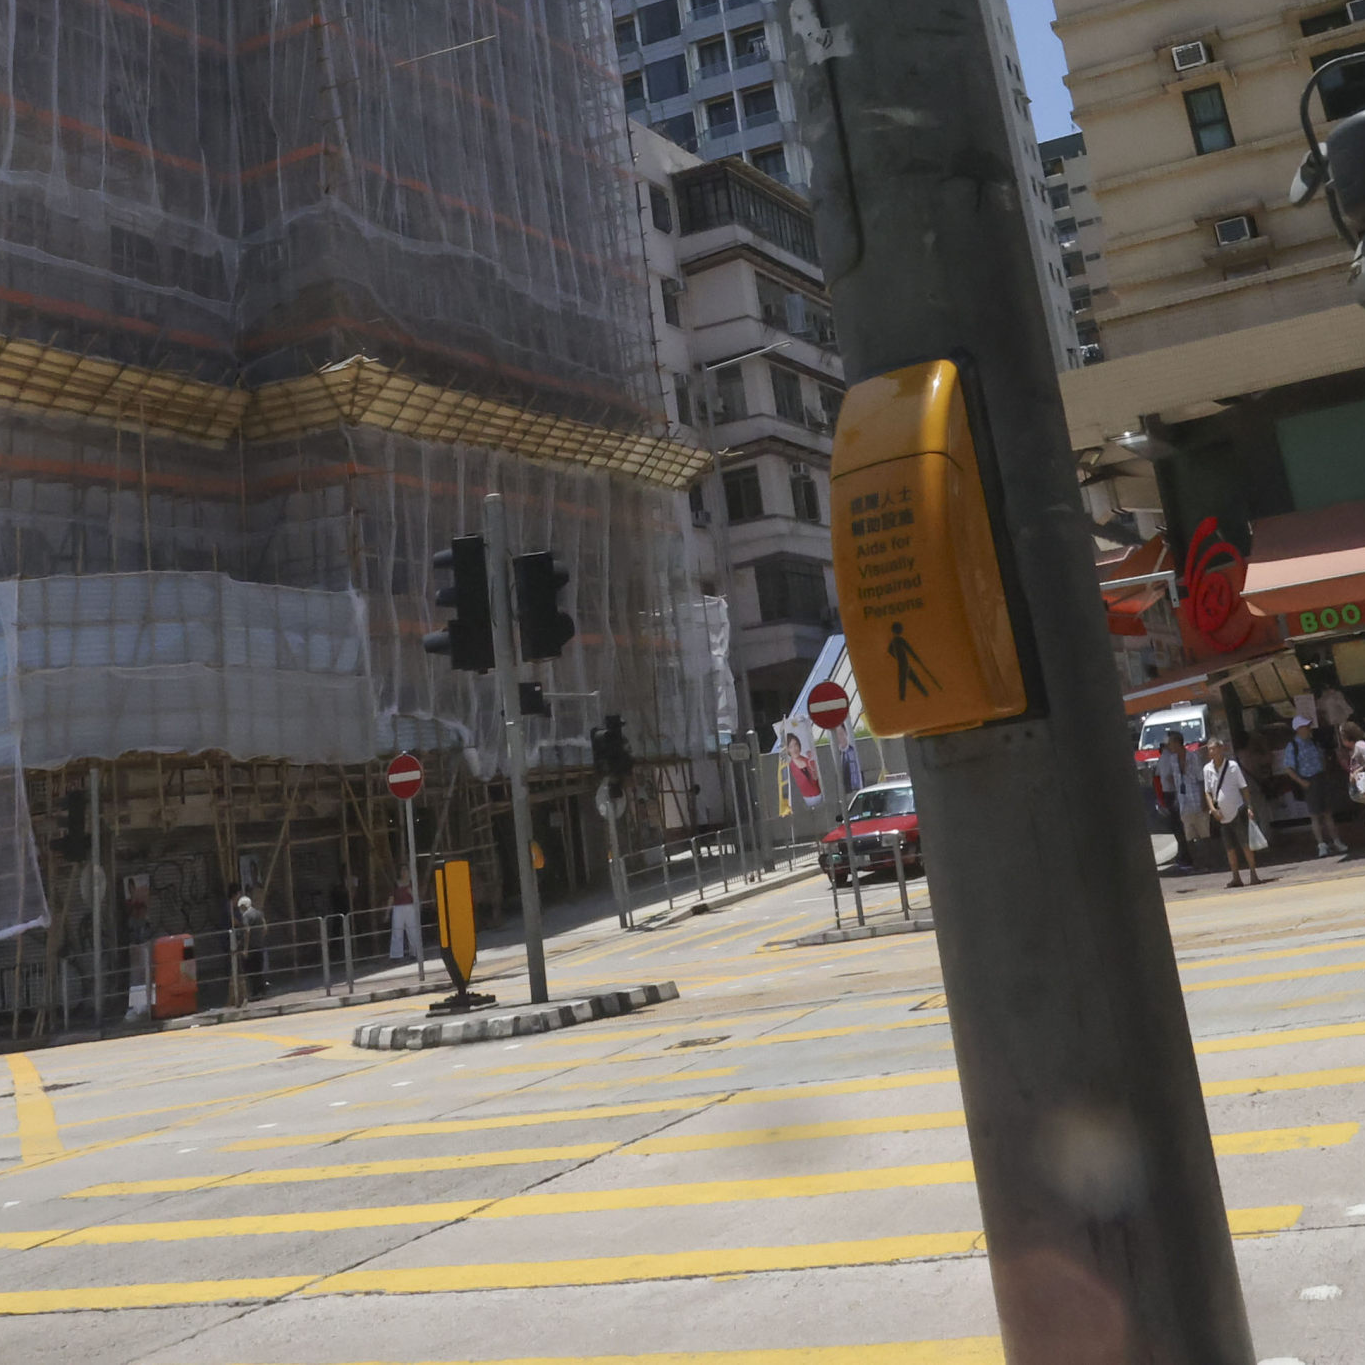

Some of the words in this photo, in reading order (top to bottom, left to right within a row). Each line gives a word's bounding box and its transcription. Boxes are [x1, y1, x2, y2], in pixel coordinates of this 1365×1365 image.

[857, 540, 887, 559] Aids
[890, 535, 912, 549] for
[858, 556, 915, 579] Visually
[858, 573, 922, 600] Impaired
[863, 597, 924, 620] Persons
[1298, 604, 1361, 633] BOO
